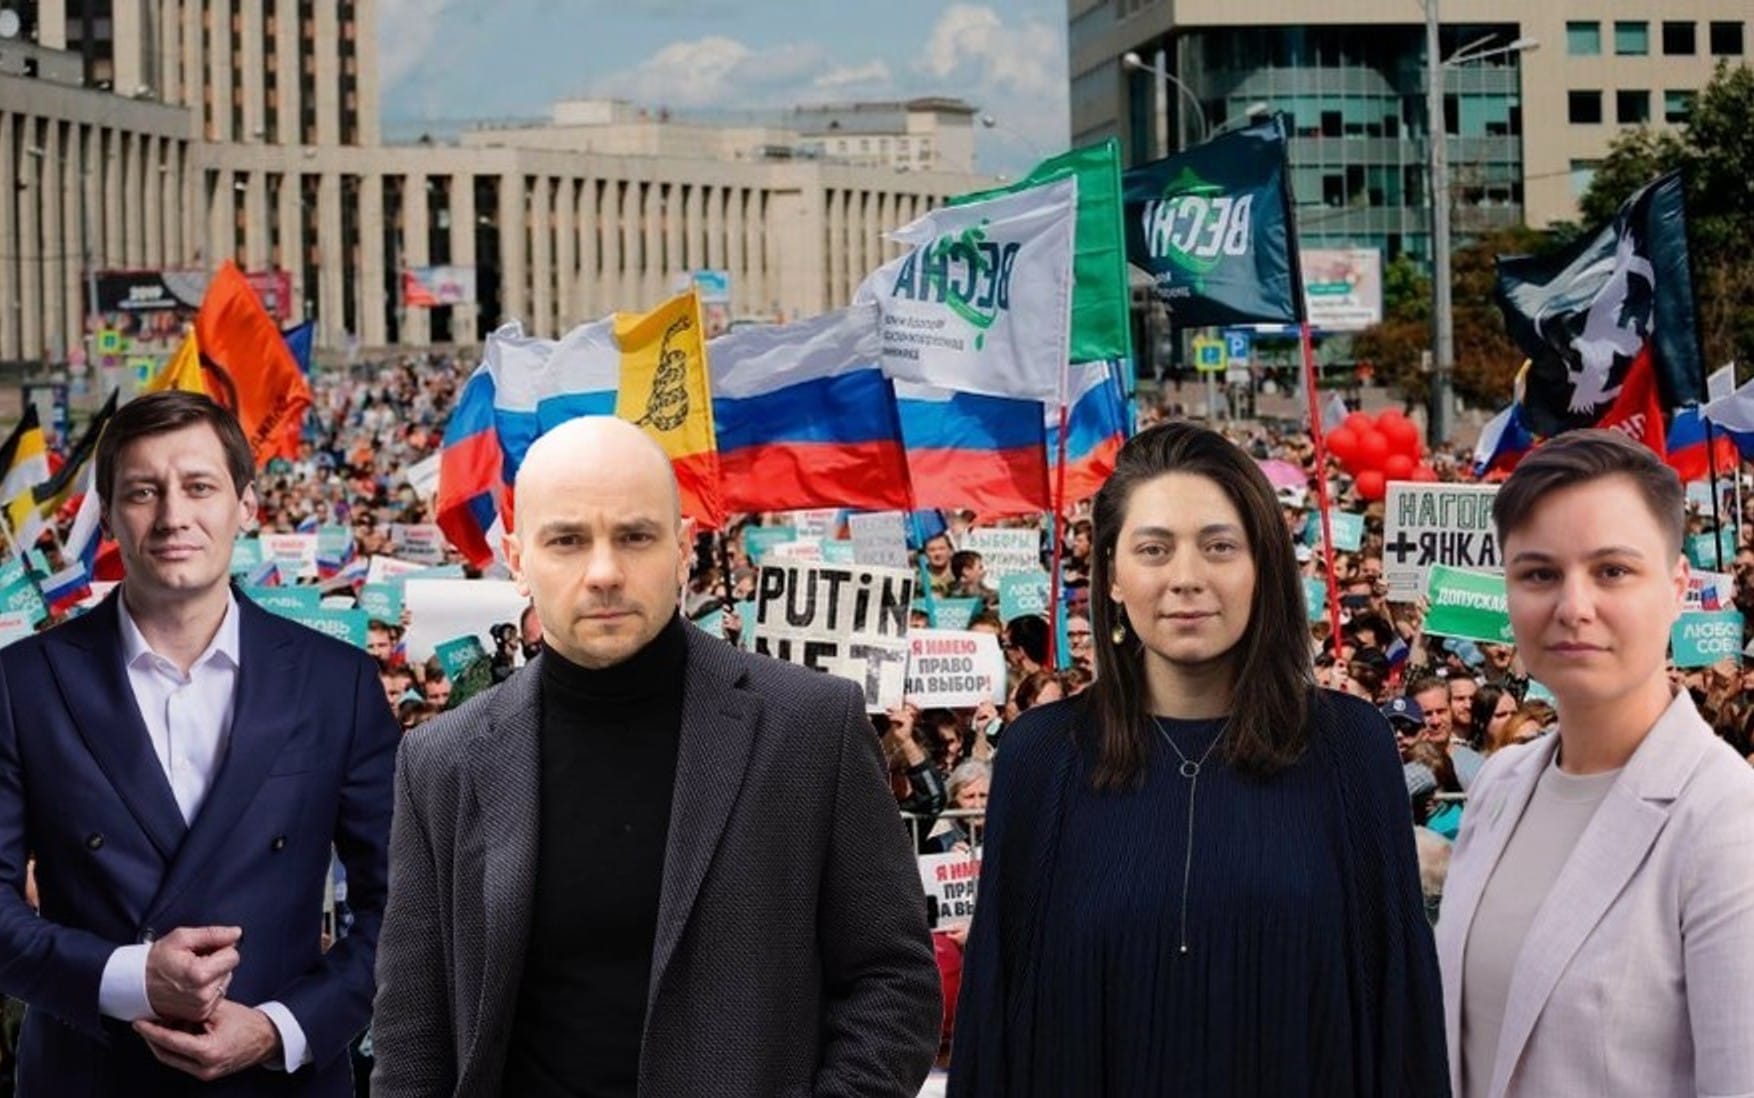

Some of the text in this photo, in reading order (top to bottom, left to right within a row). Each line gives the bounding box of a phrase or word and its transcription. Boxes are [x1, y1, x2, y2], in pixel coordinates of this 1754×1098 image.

[1386, 531, 1504, 567] +ЯНКА
[912, 639, 977, 656] Я ИМЕЮ
[918, 657, 973, 675] ПРАВО
[927, 675, 991, 693] ВЫБОР!
[936, 863, 947, 881] Я
